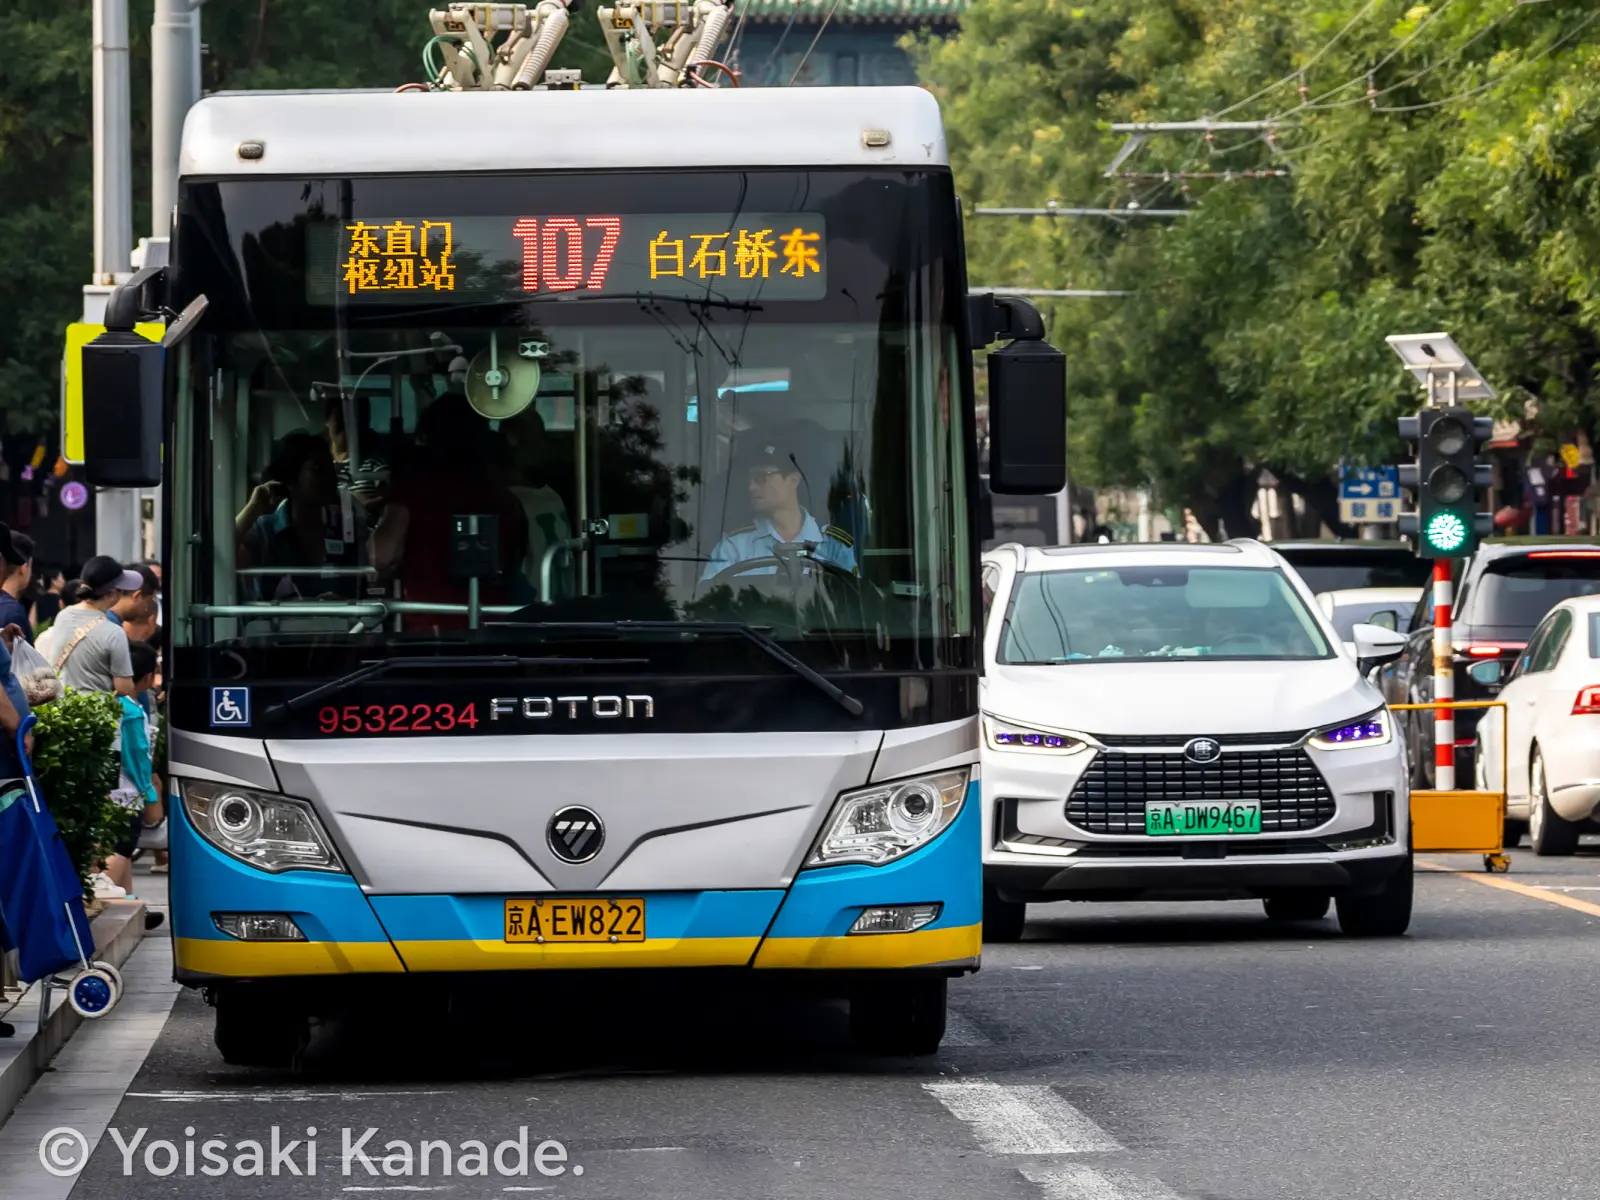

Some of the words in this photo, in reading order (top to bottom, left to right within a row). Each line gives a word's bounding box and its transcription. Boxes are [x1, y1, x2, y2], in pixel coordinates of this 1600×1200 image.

[346, 220, 452, 258] 东直门
[513, 217, 620, 291] 107
[649, 227, 822, 279] 白石桥东
[342, 256, 456, 295] 枢纽站
[318, 703, 479, 733] 9532234
[490, 694, 655, 721] FOTON
